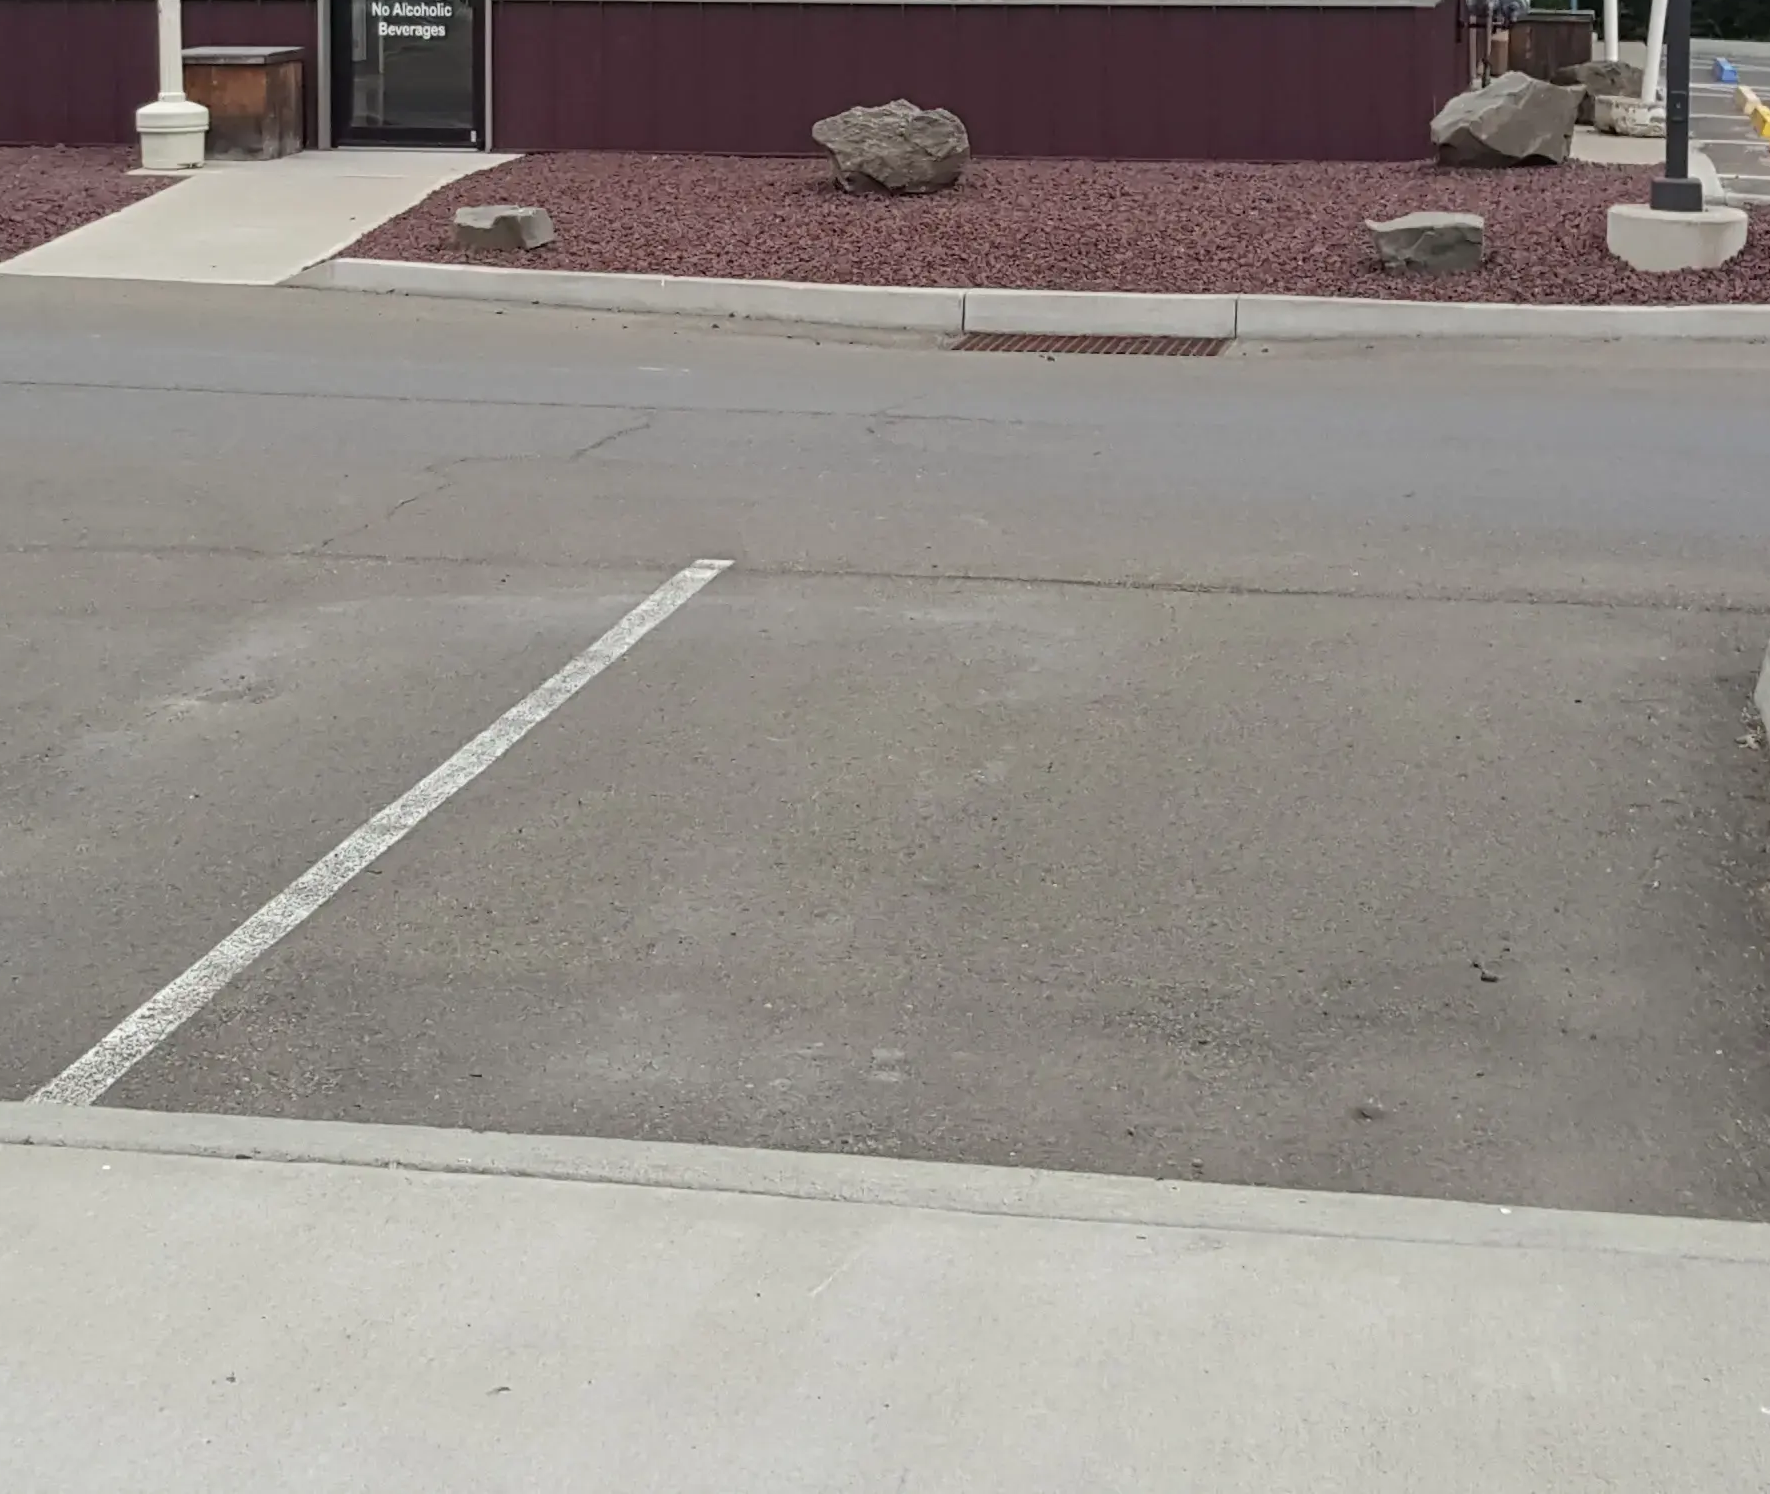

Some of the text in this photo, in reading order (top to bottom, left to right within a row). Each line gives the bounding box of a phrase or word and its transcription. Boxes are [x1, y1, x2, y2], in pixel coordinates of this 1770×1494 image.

[372, 2, 452, 17] No Alcoholic
[378, 21, 446, 39] Beverages
